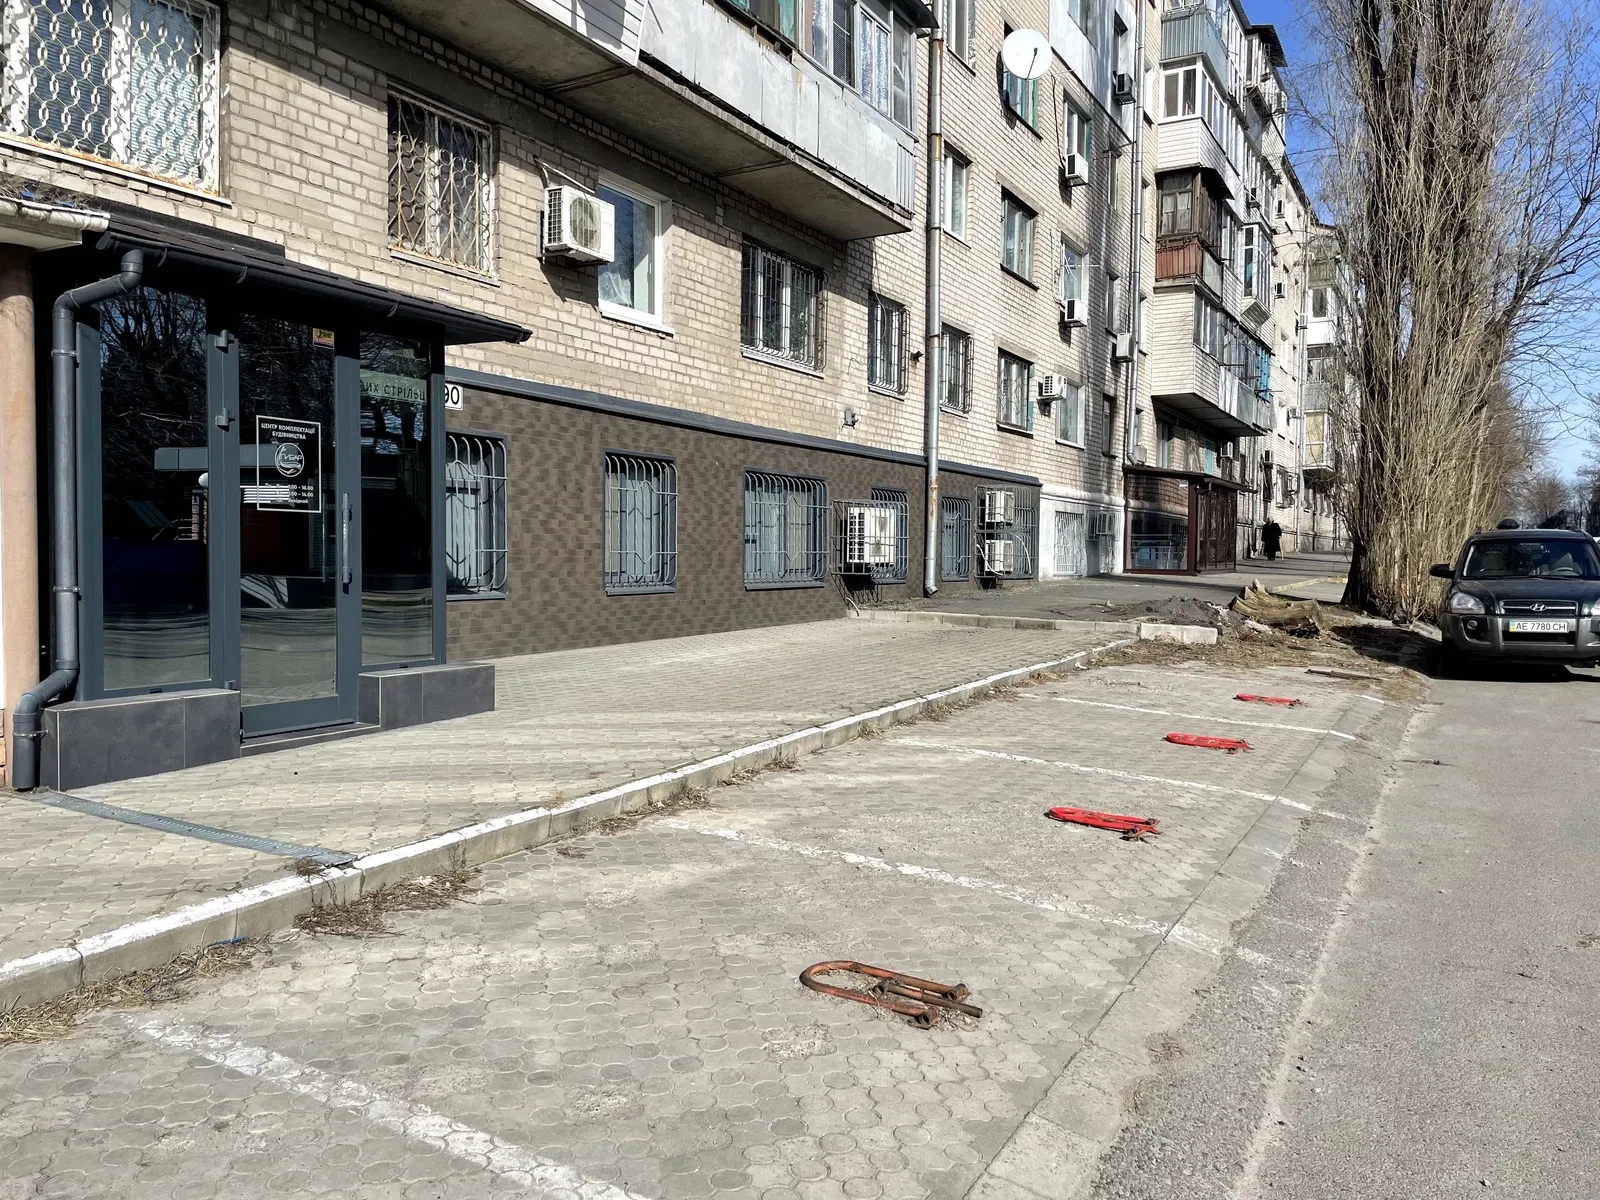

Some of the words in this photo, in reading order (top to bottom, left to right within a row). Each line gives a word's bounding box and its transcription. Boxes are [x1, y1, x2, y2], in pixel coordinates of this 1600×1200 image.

[272, 431, 306, 439] БУДІВНИЦТВА
[1516, 622, 1529, 631] AE
[1530, 622, 1551, 631] 7780
[1552, 623, 1566, 631] CH
